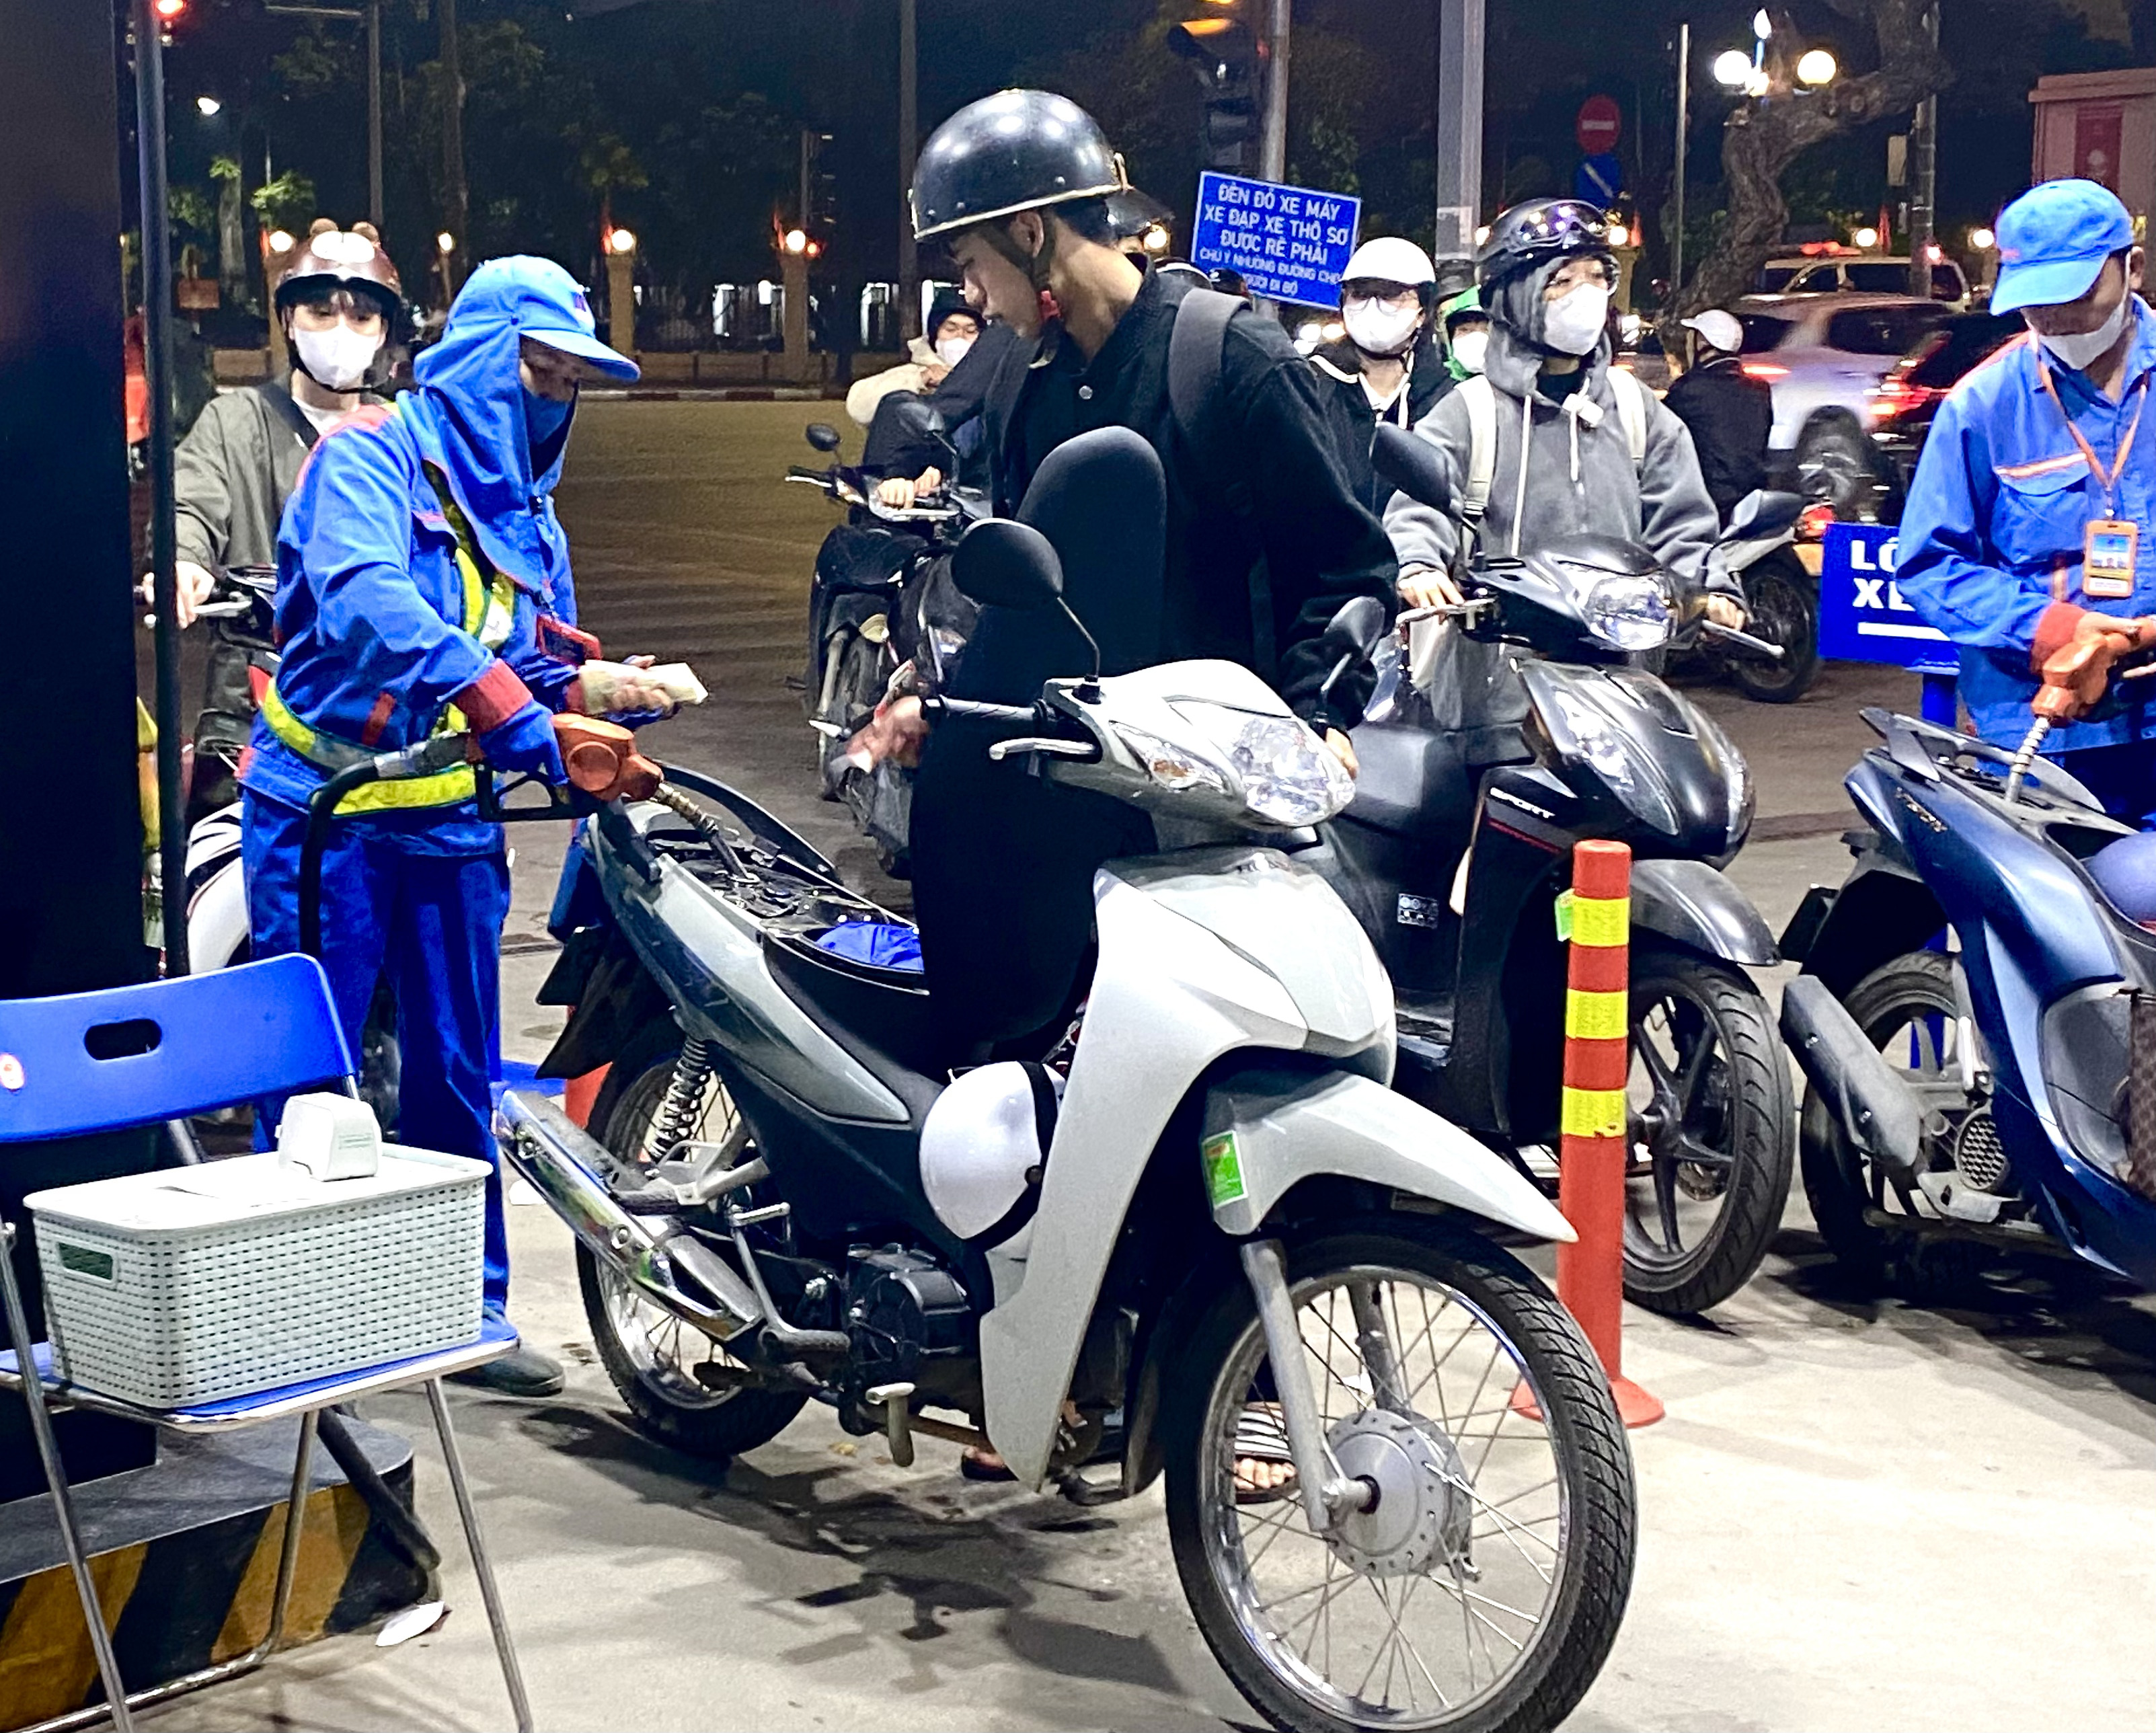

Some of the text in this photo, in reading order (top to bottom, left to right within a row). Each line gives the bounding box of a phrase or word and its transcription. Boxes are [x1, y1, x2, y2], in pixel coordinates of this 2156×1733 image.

[1204, 204, 1226, 223] XE
[1264, 214, 1285, 235] XE
[1290, 220, 1321, 241] THÔ
[1280, 194, 1301, 215] XE
[1305, 199, 1341, 221] MÁY
